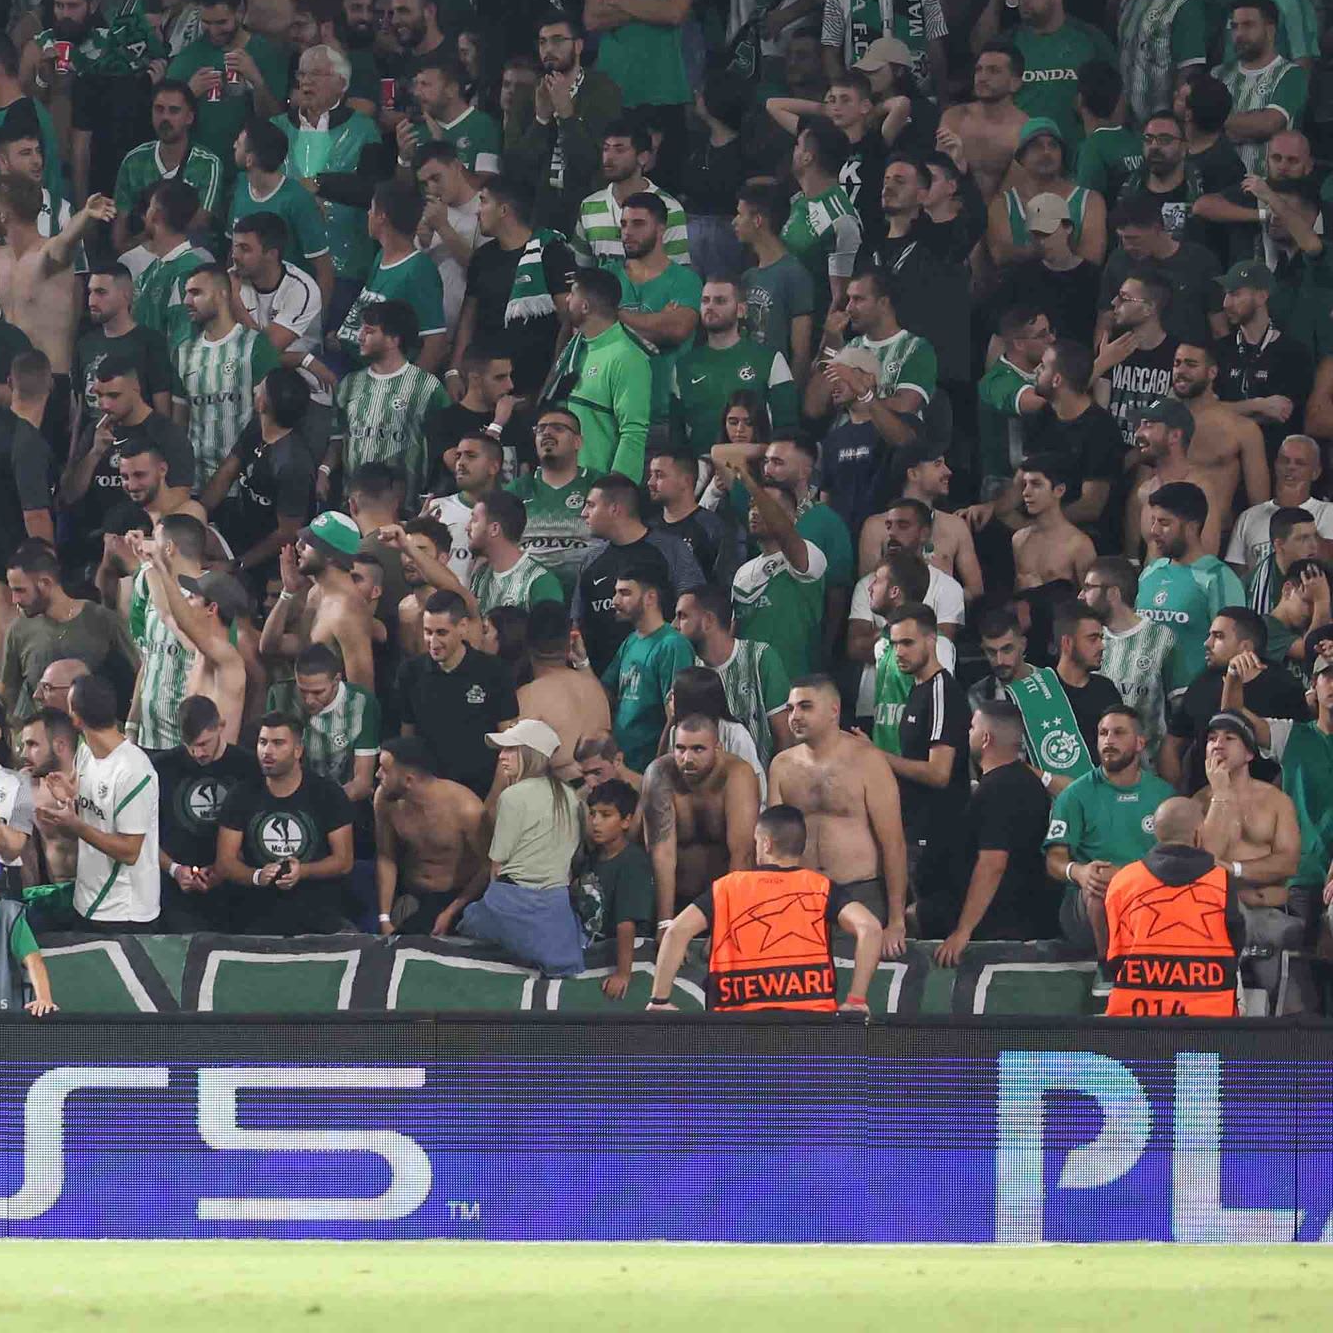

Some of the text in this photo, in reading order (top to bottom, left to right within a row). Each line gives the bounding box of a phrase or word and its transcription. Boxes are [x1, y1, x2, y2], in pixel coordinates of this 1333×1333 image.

[1021, 69, 1078, 83] ONDA
[1112, 363, 1172, 396] MACCABI
[1116, 962, 1224, 987] EWARD
[1131, 998, 1189, 1017] 014
[994, 1050, 1333, 1243] PL
